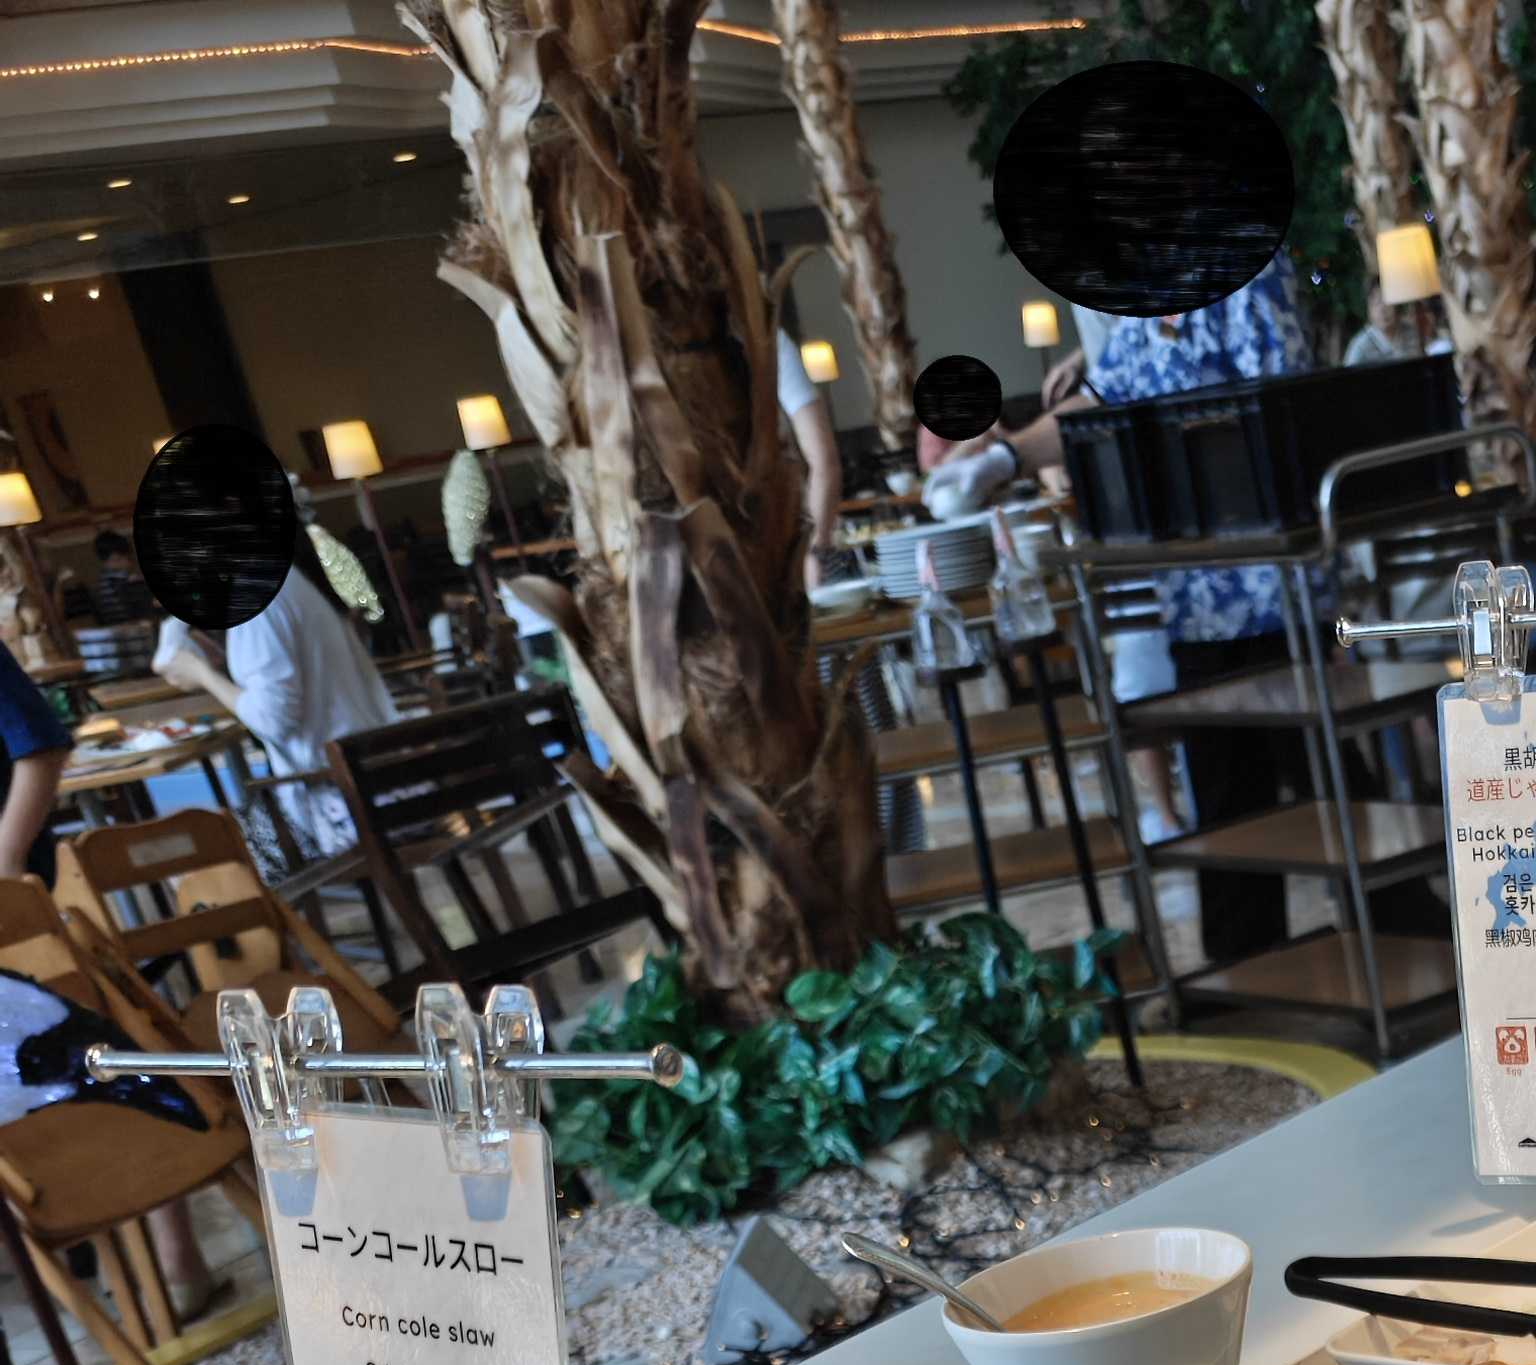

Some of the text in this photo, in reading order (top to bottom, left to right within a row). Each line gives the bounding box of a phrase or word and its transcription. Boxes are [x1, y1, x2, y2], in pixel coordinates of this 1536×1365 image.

[1457, 824, 1506, 842] Black
[1503, 873, 1533, 893] 검은
[298, 1222, 524, 1276] コーンコールスロー
[342, 1305, 495, 1347] Corn cole slaw
